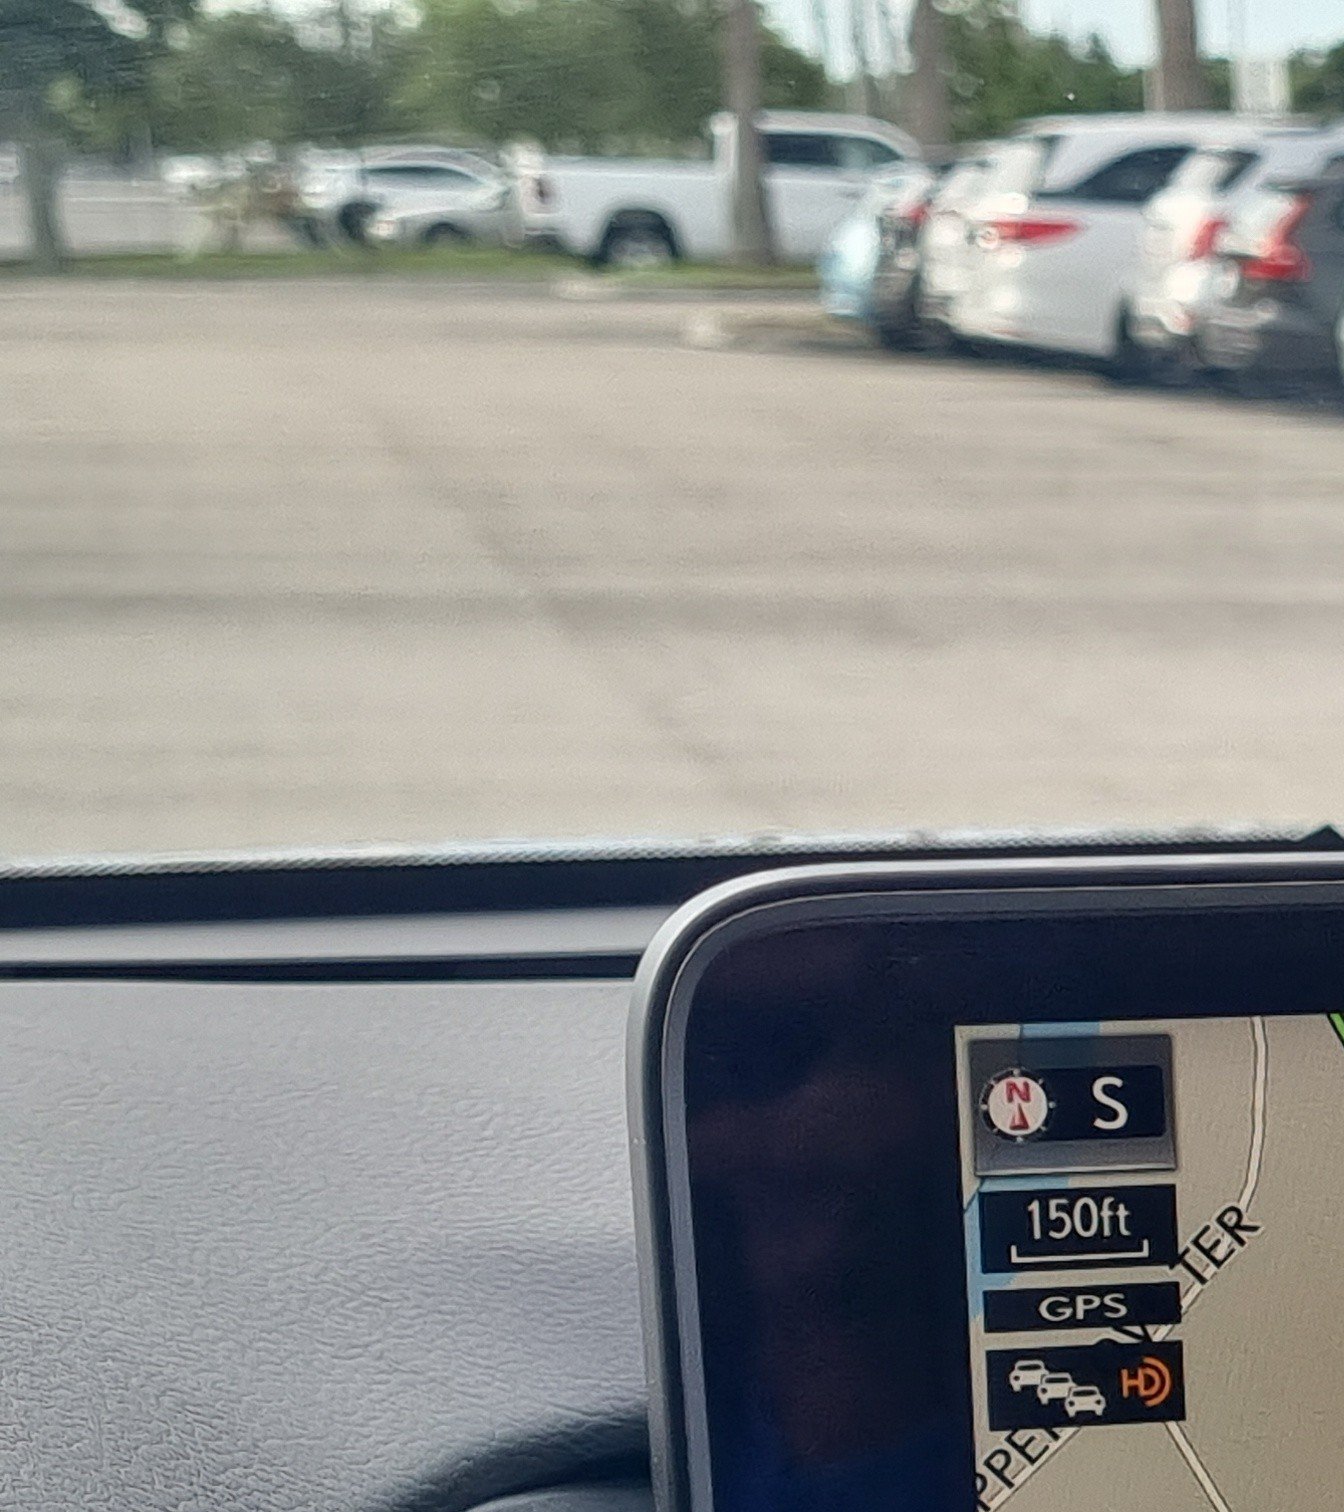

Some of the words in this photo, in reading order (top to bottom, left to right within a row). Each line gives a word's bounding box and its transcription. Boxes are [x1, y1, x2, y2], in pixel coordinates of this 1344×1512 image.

[1005, 1081, 1031, 1103] N
[1091, 1075, 1129, 1131] S
[1027, 1196, 1132, 1241] 150ft
[1169, 1206, 1261, 1286] TER
[1038, 1292, 1129, 1322] GPS
